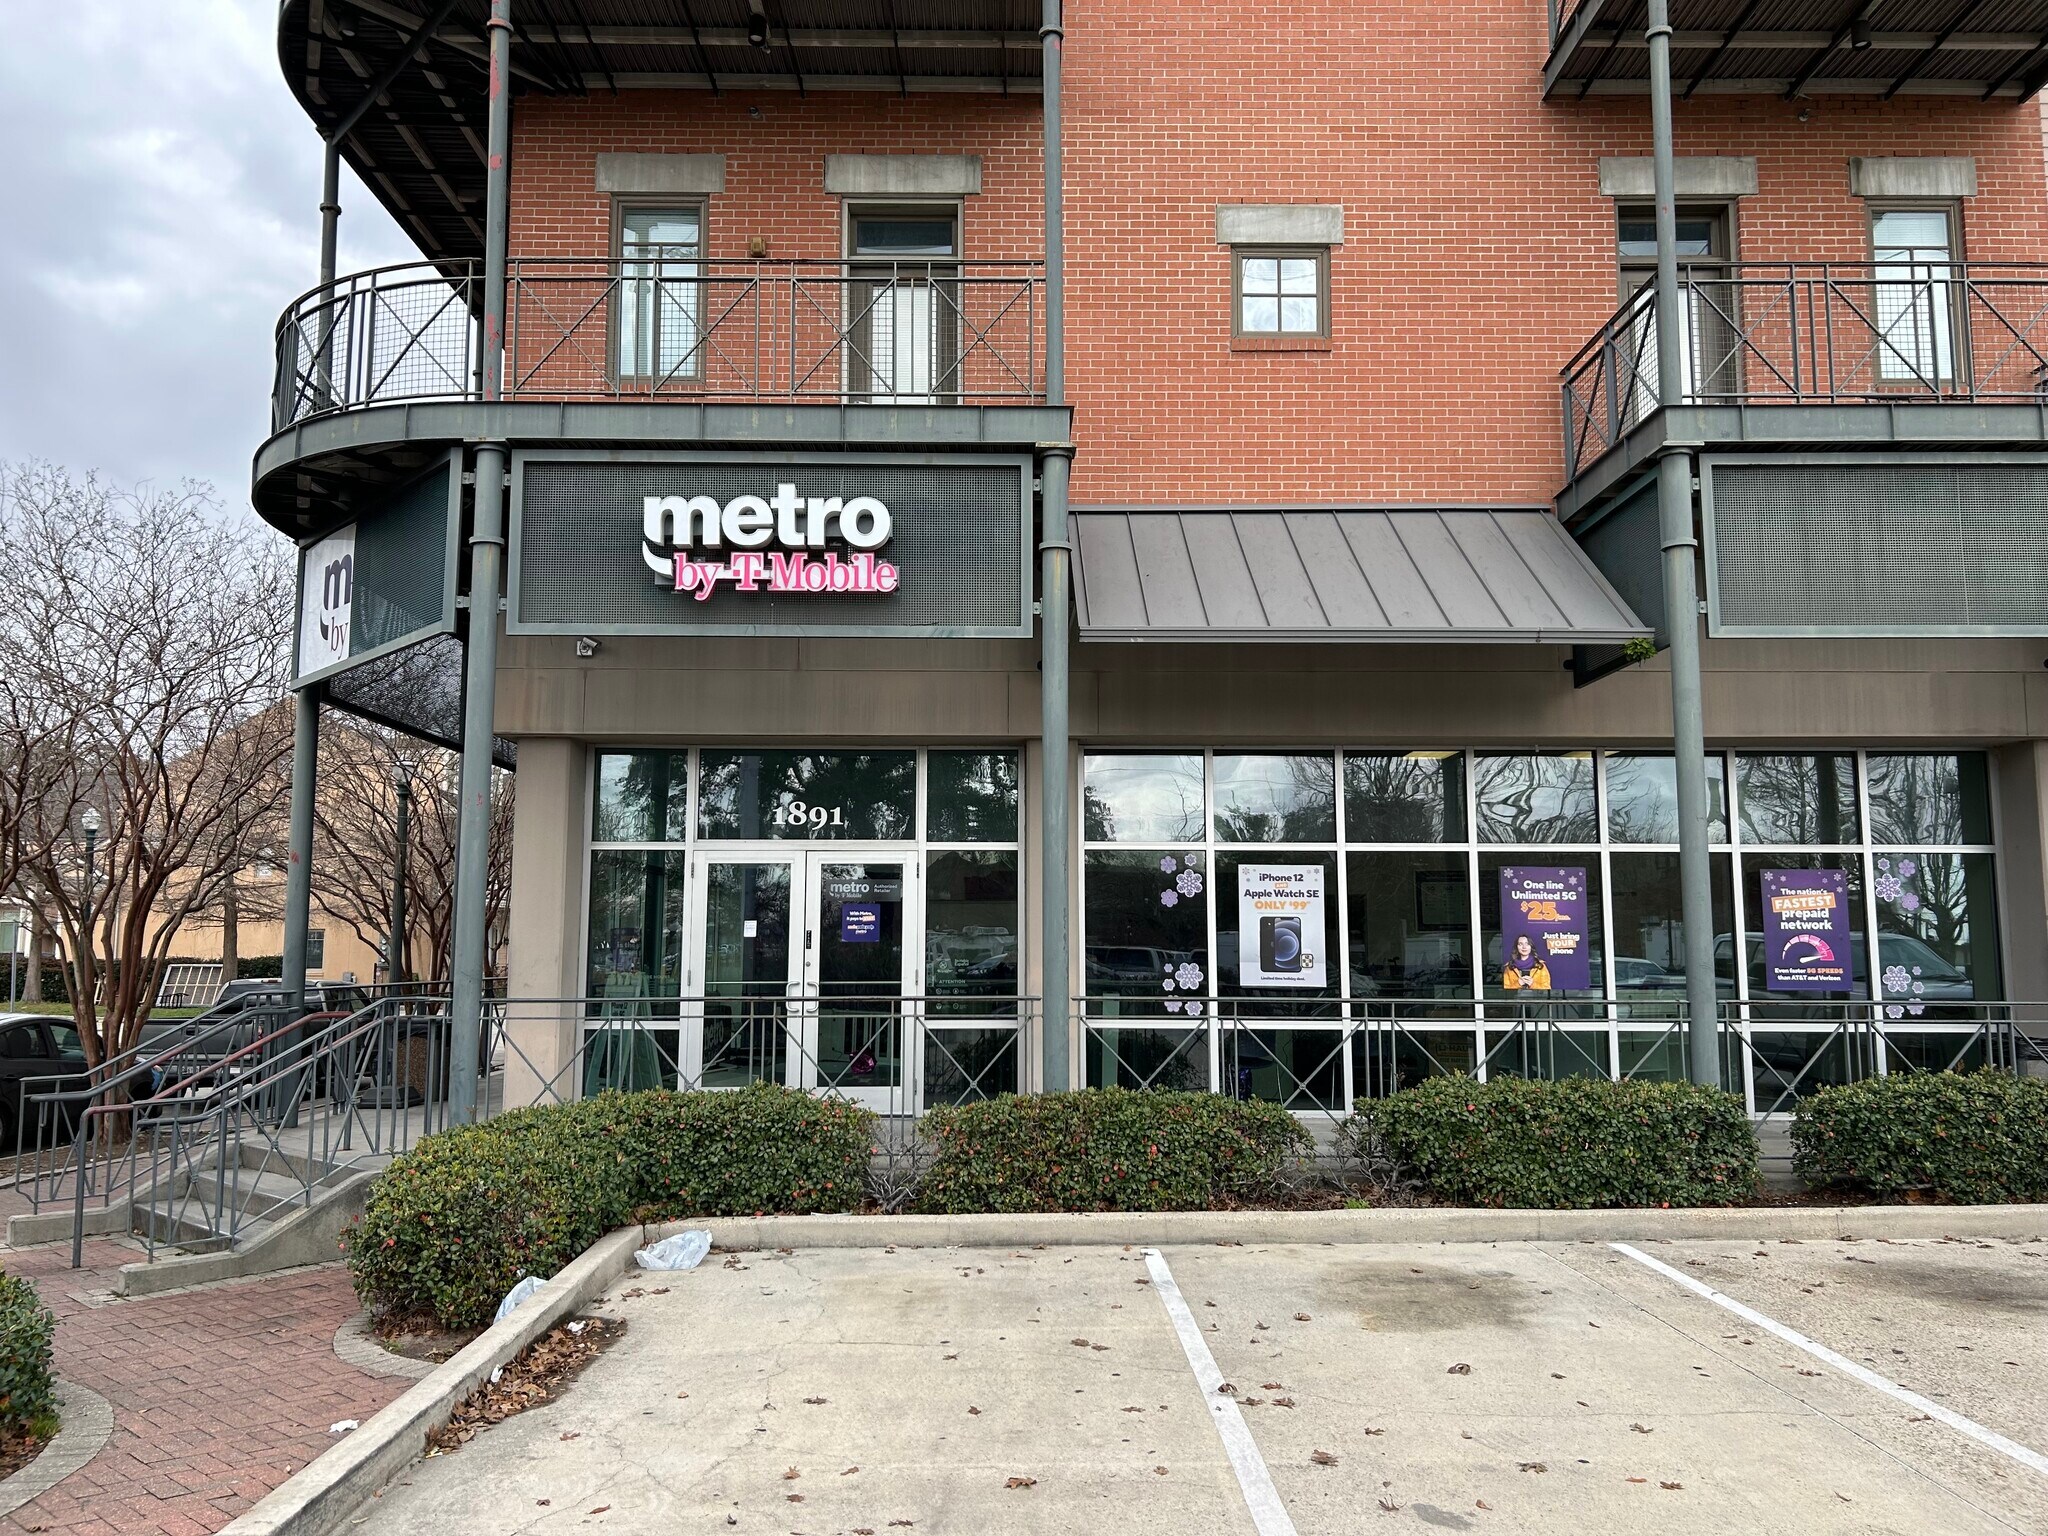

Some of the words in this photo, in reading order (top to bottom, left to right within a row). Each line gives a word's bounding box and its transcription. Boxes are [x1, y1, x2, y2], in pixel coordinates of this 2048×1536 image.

[642, 482, 893, 550] metro
[674, 552, 723, 600] by
[330, 616, 348, 660] by
[772, 800, 844, 831] 1891
[1259, 873, 1292, 882] iPhone
[1293, 873, 1304, 882] 12
[830, 882, 870, 892] metro
[1523, 880, 1545, 890] One
[1546, 880, 1564, 890] line
[1244, 889, 1272, 899] Apple
[1273, 889, 1305, 898] Watch
[1306, 890, 1319, 898] SE
[1511, 890, 1561, 900] Unlimited
[1562, 892, 1577, 900] 5G
[1254, 900, 1286, 910] ONLY
[1775, 896, 1832, 910] FASTEST
[1782, 909, 1829, 920] prepaid
[1780, 920, 1832, 930] network
[1560, 932, 1580, 941] bring
[1550, 947, 1574, 955] phone
